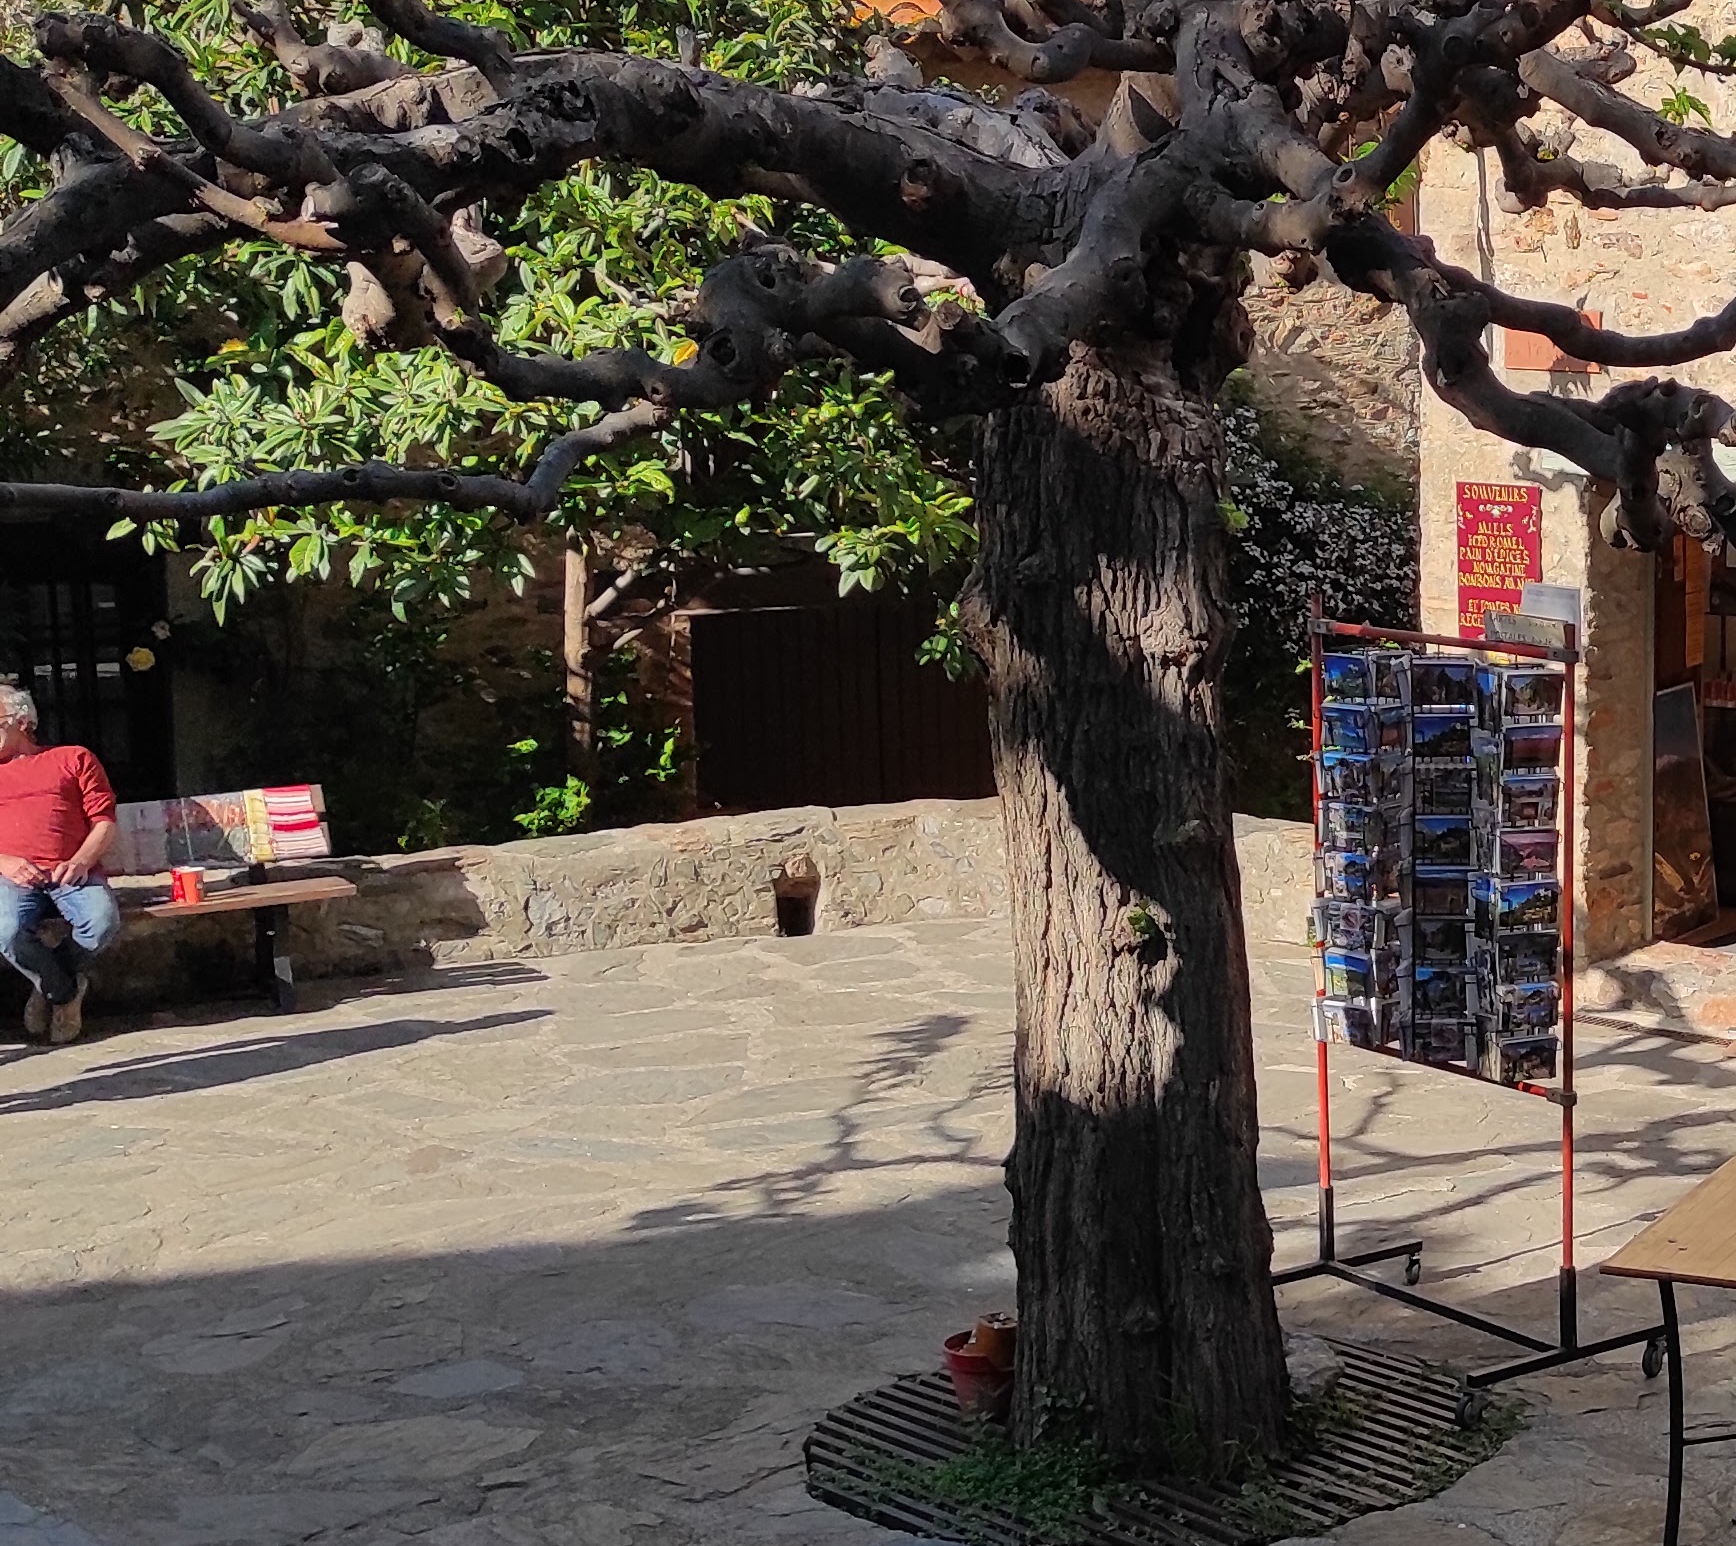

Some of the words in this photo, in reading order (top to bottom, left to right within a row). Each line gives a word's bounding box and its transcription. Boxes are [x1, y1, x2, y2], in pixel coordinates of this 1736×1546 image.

[1462, 484, 1528, 503] SOUVENIRS
[1477, 520, 1514, 536] MIELS
[1459, 546, 1482, 561] PAIN
[1472, 561, 1526, 577] NOUGATINE
[1458, 572, 1502, 589] BONBONS
[1467, 598, 1479, 612] ET
